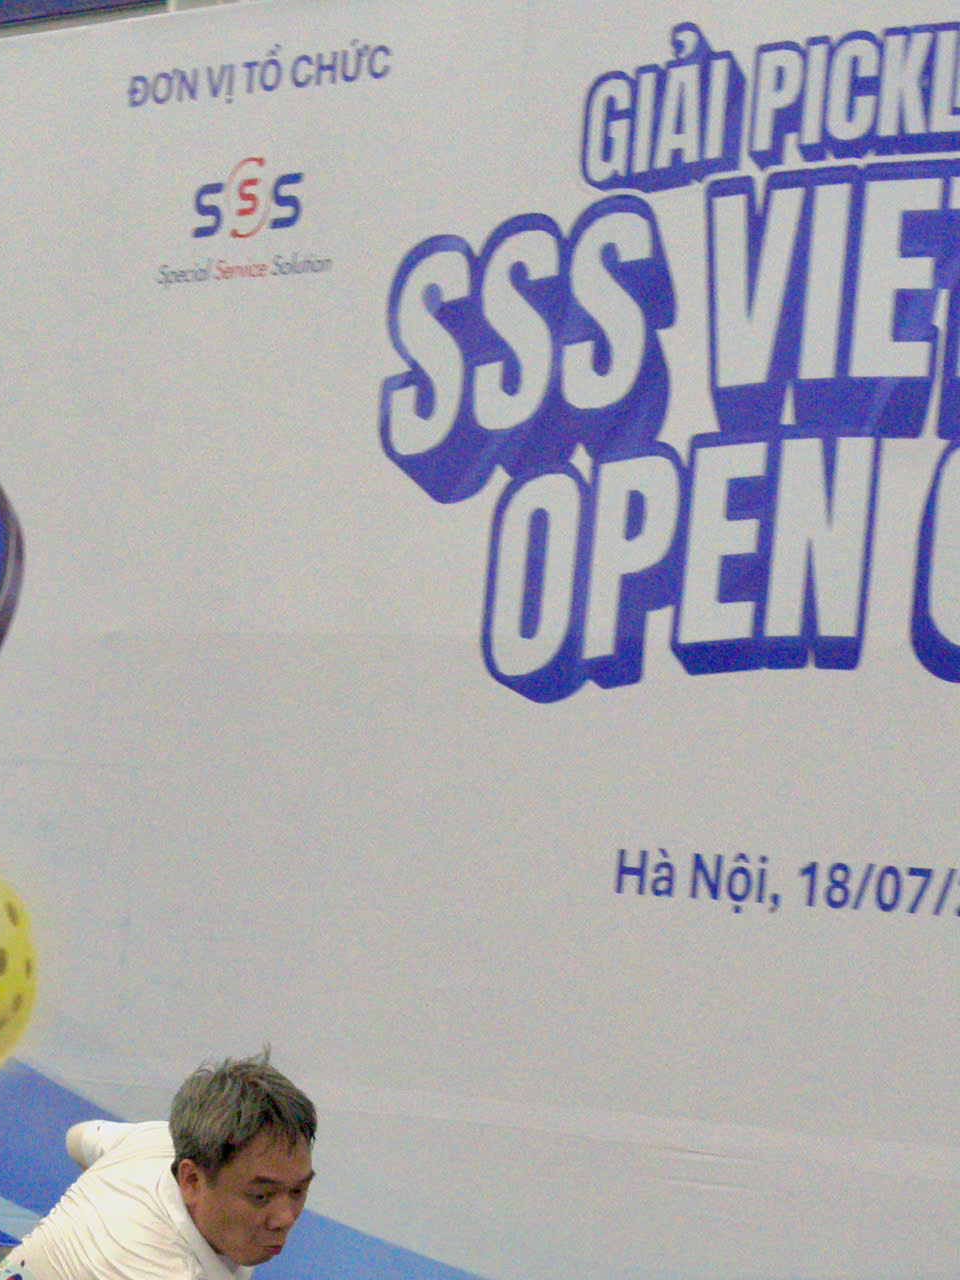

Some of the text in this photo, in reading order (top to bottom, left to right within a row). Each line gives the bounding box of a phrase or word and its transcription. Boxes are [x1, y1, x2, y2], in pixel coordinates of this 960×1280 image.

[128, 39, 393, 108] ĐƠN VỊ TỔ CHỨC
[584, 24, 740, 190] GIẢI
[192, 162, 304, 238] SSS
[214, 259, 268, 281] Service
[270, 252, 333, 276] Solution
[380, 164, 960, 490] SSS VIE
[483, 435, 880, 692] OPEN
[614, 848, 960, 917] Hà Nội, 18/07/
